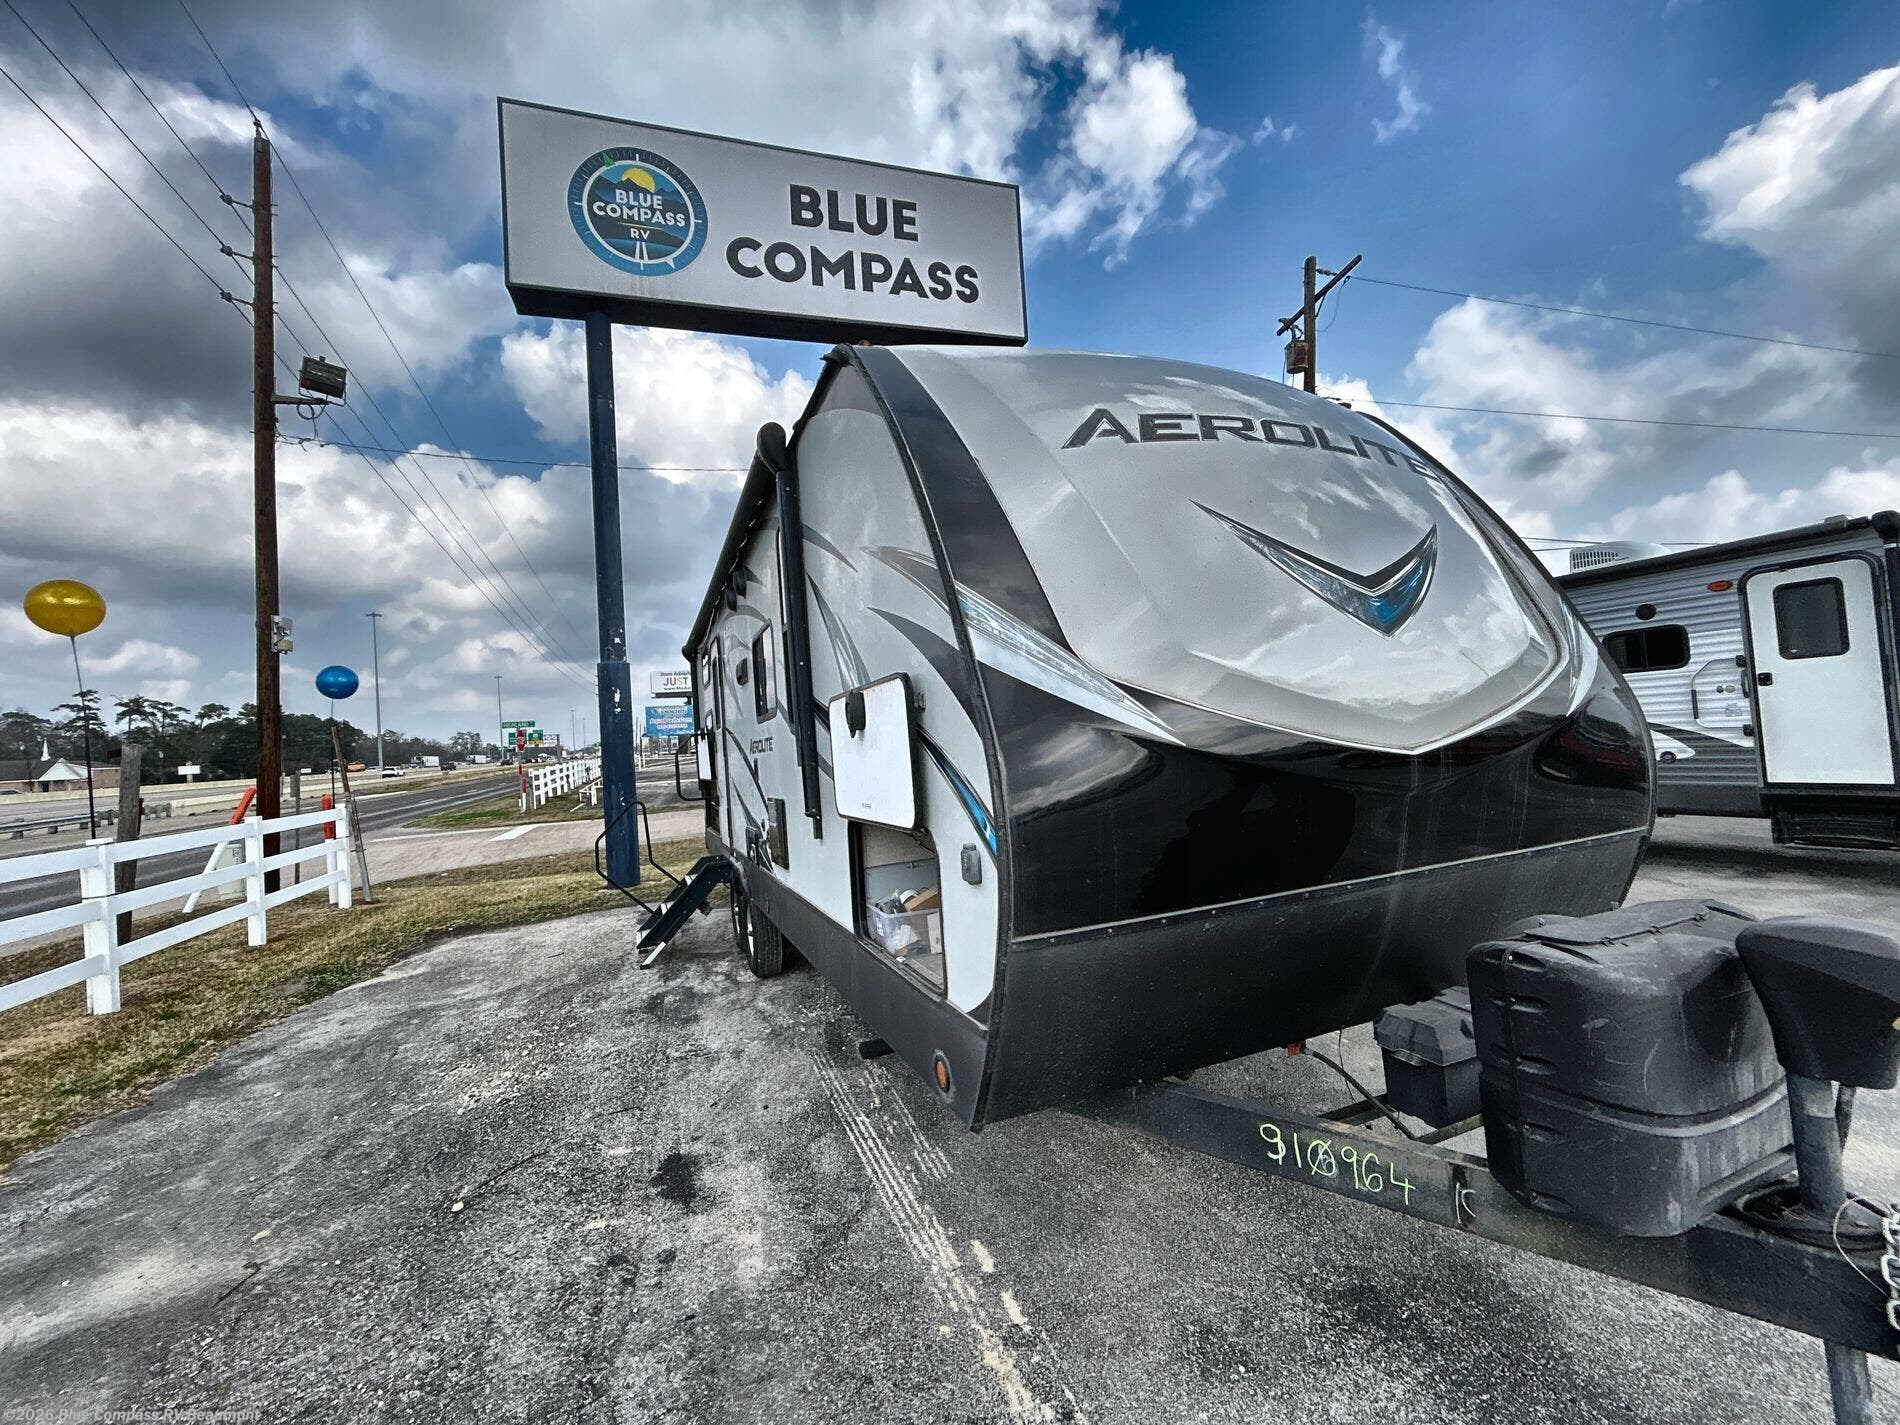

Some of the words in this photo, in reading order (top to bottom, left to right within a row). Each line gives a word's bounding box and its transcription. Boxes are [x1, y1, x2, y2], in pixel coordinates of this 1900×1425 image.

[615, 189, 663, 210] BLUE
[789, 183, 919, 242] BLUE
[592, 201, 686, 227] COMPASS
[630, 228, 650, 240] RV
[726, 236, 980, 304] COMPASS
[1060, 407, 1443, 484] AEROLITE
[663, 677, 689, 686] JUST
